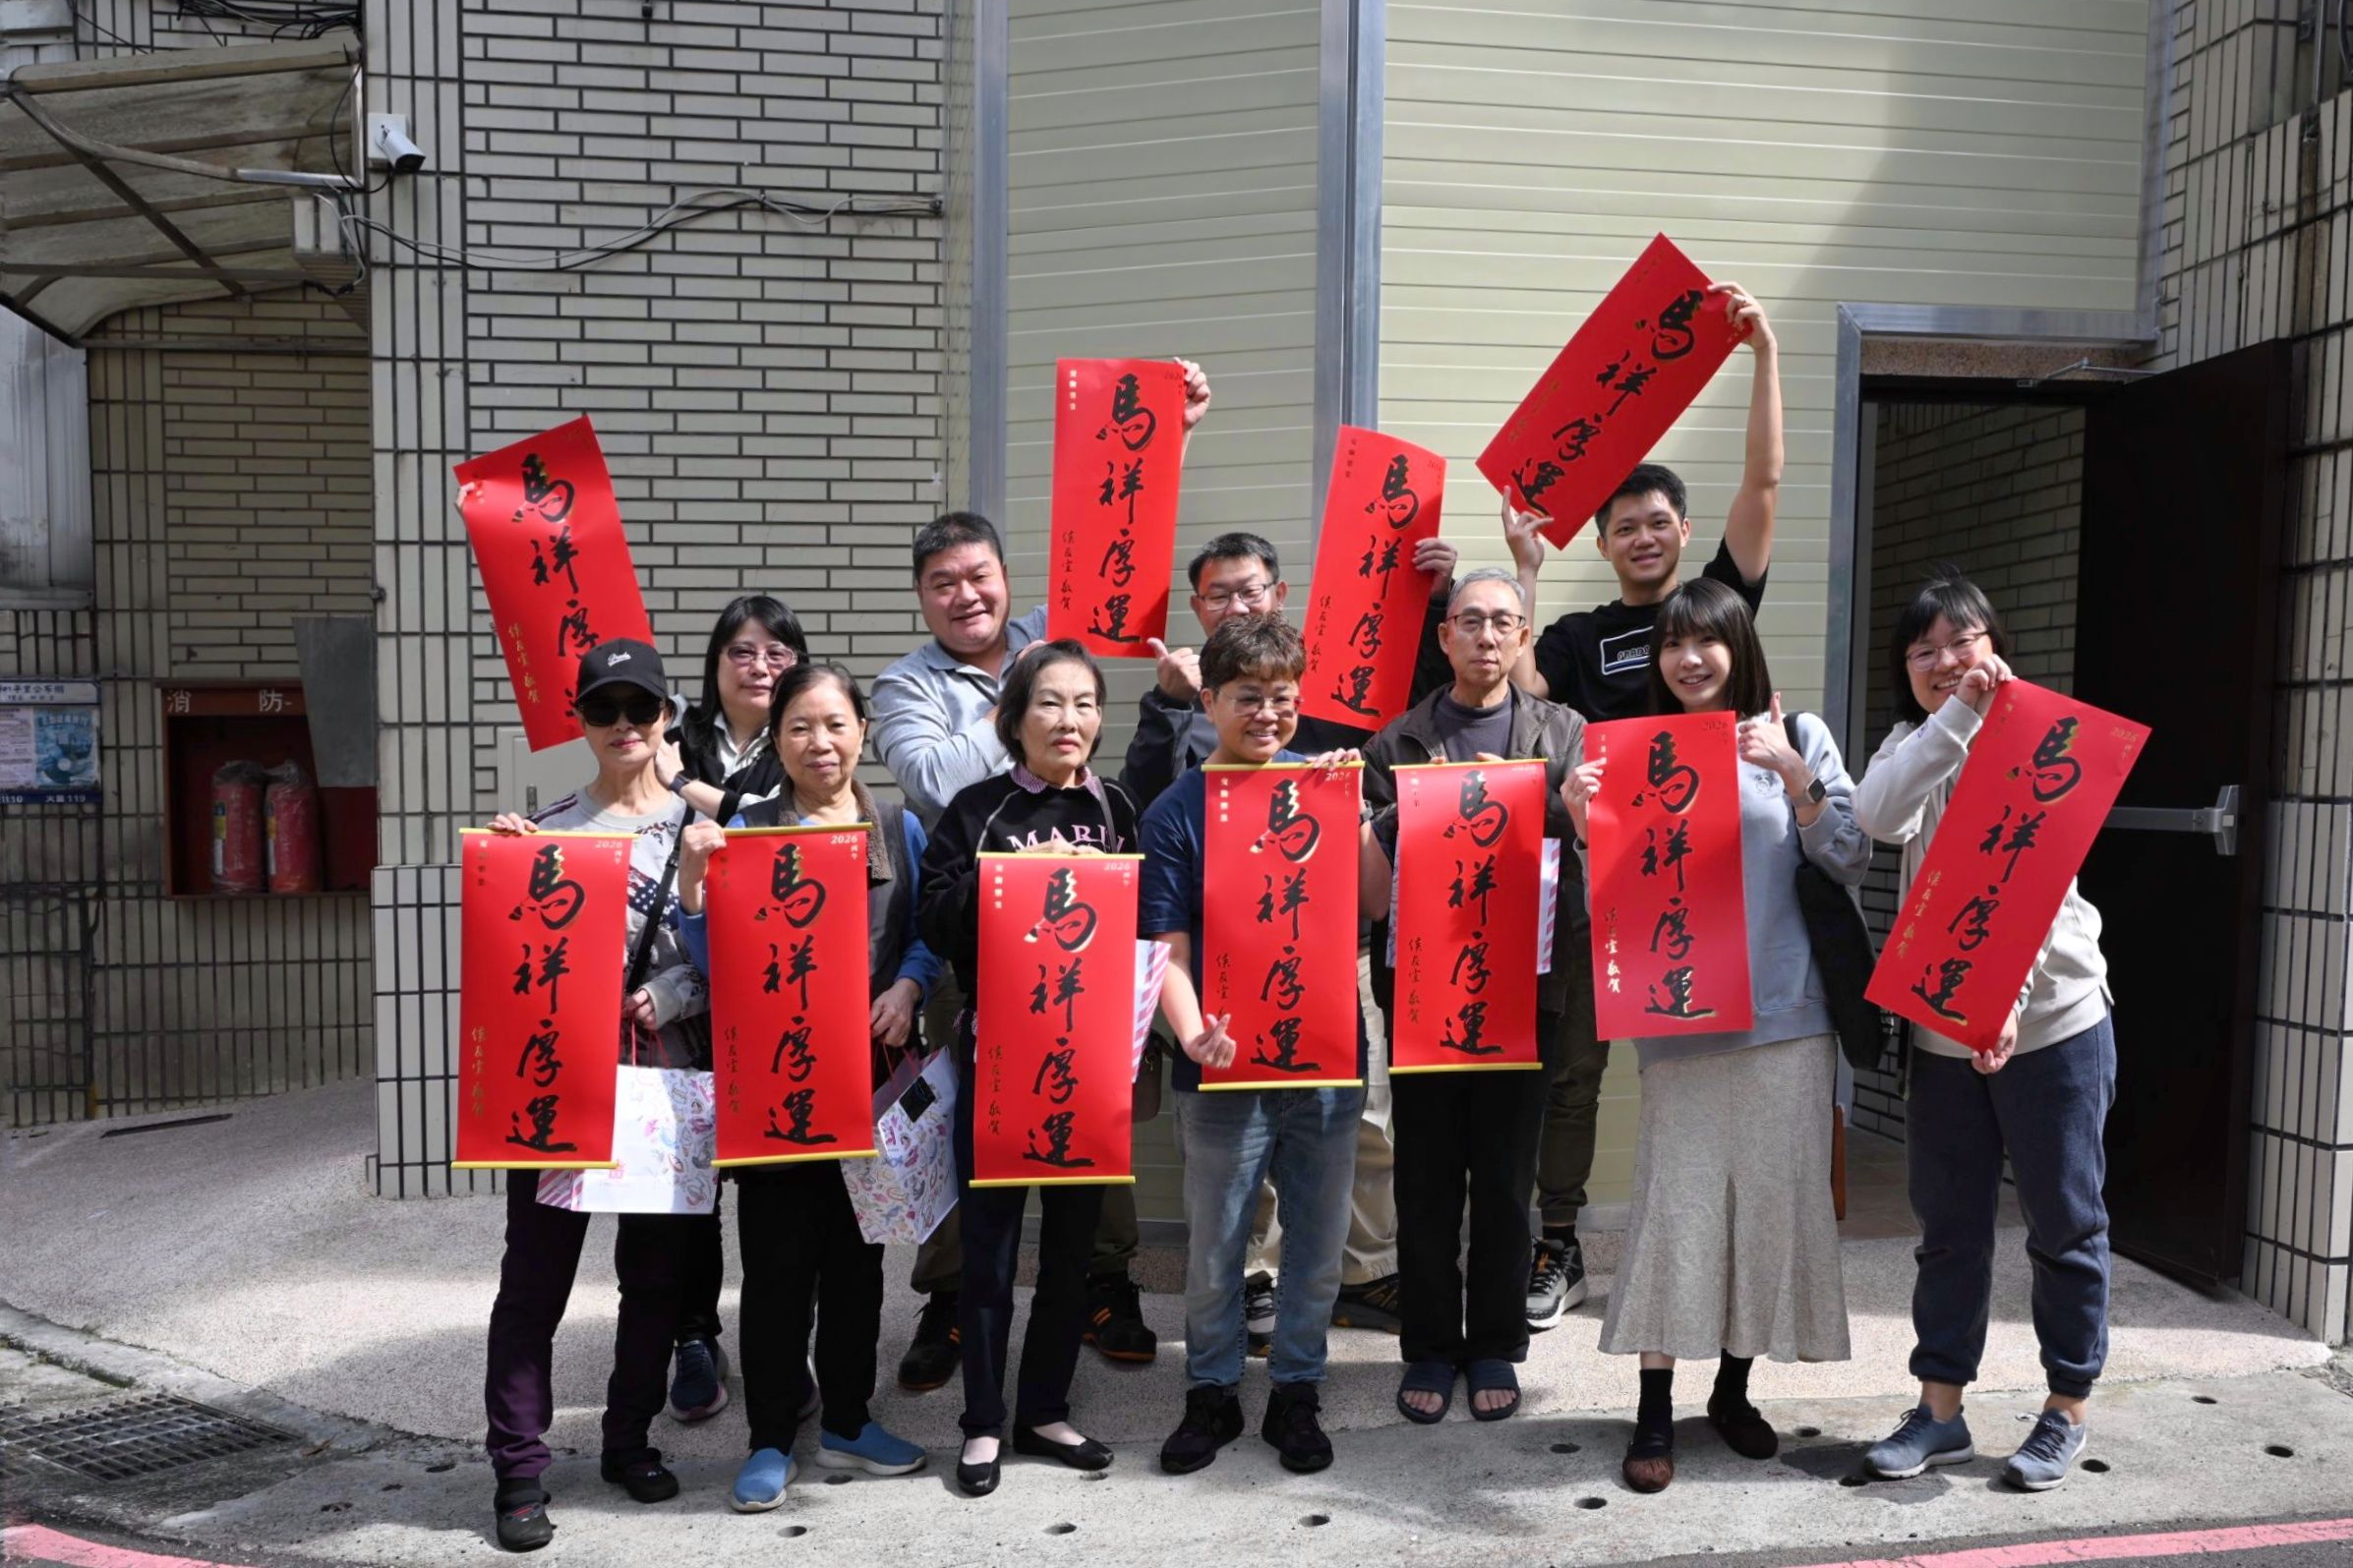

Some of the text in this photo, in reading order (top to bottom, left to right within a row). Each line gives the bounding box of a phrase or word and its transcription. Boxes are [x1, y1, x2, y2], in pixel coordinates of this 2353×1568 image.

[511, 452, 601, 718] 馬祥厚
[1088, 374, 1156, 643] 馬祥厚運
[1332, 454, 1419, 718] 馬祥厚運
[595, 841, 623, 849] 2026
[830, 834, 858, 844] 2026
[1103, 862, 1131, 872] 2026
[1908, 717, 2082, 1026] 馬祥厚運
[2110, 726, 2140, 742] 2026
[506, 843, 586, 1152] 馬祥厚運
[754, 842, 839, 1146] 馬祥厚運
[1249, 779, 1322, 1073] 馬祥厚運
[1441, 771, 1510, 1057] 馬祥厚運
[1632, 730, 1717, 1019] 馬祥厚運
[1023, 867, 1096, 1169] 馬祥厚運
